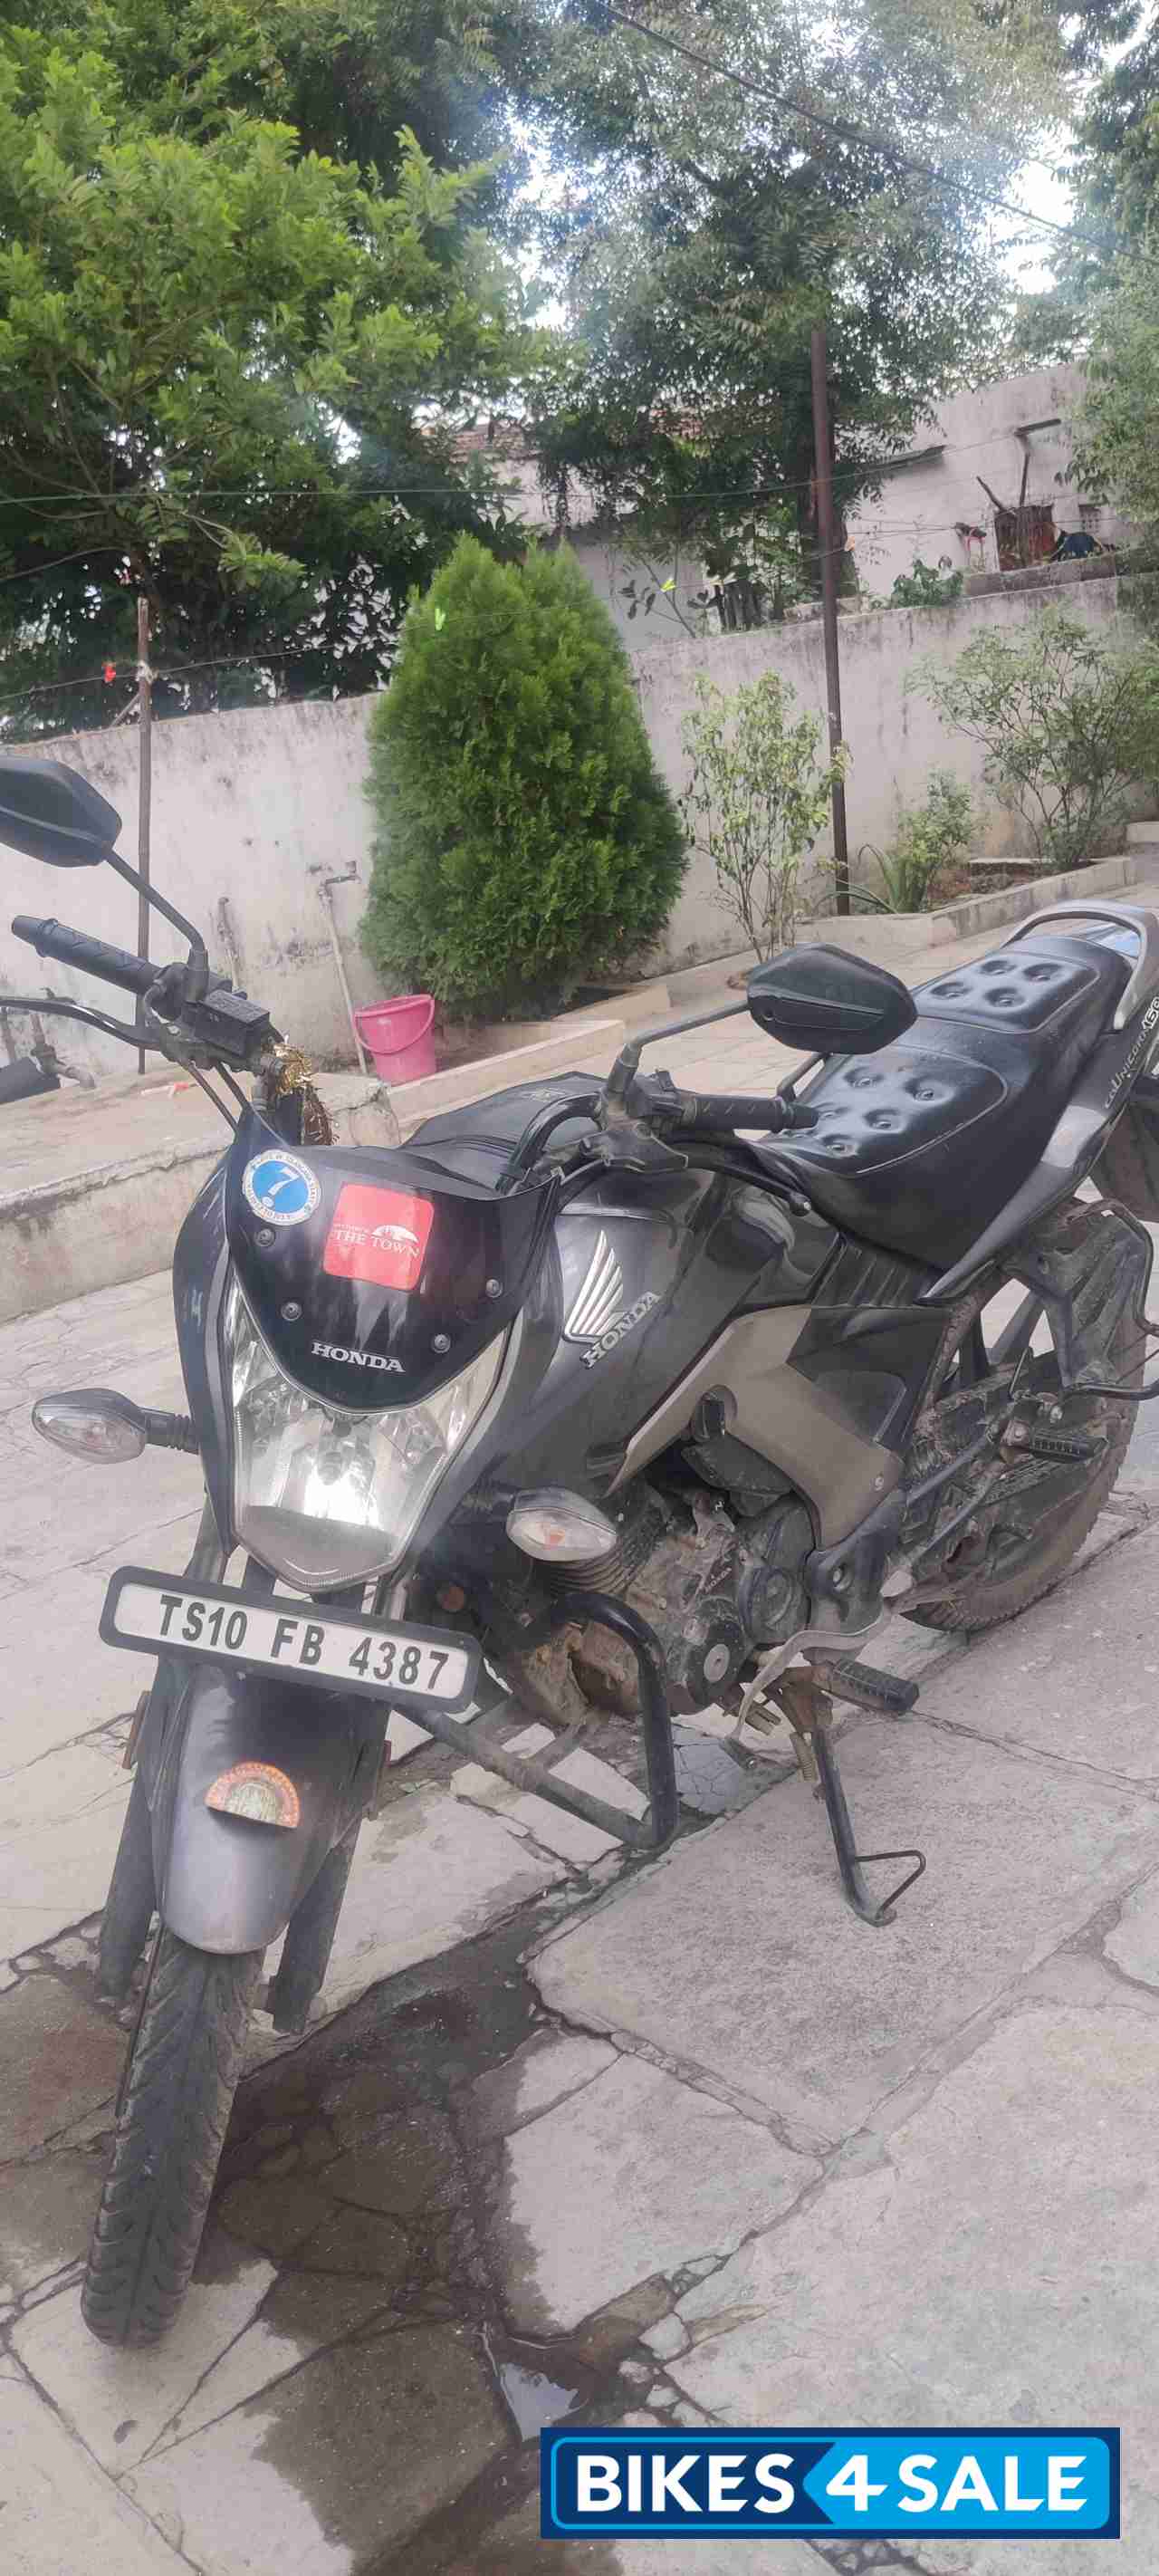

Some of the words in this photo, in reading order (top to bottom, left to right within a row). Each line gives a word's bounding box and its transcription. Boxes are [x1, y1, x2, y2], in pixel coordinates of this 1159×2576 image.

[335, 1230, 368, 1244] THE
[370, 1236, 421, 1259] TOWN
[311, 1341, 407, 1373] HONDA
[580, 1290, 663, 1370] HONDA
[158, 1593, 248, 1651] TS10
[269, 1617, 326, 1667] FB
[347, 1636, 450, 1691] 4387
